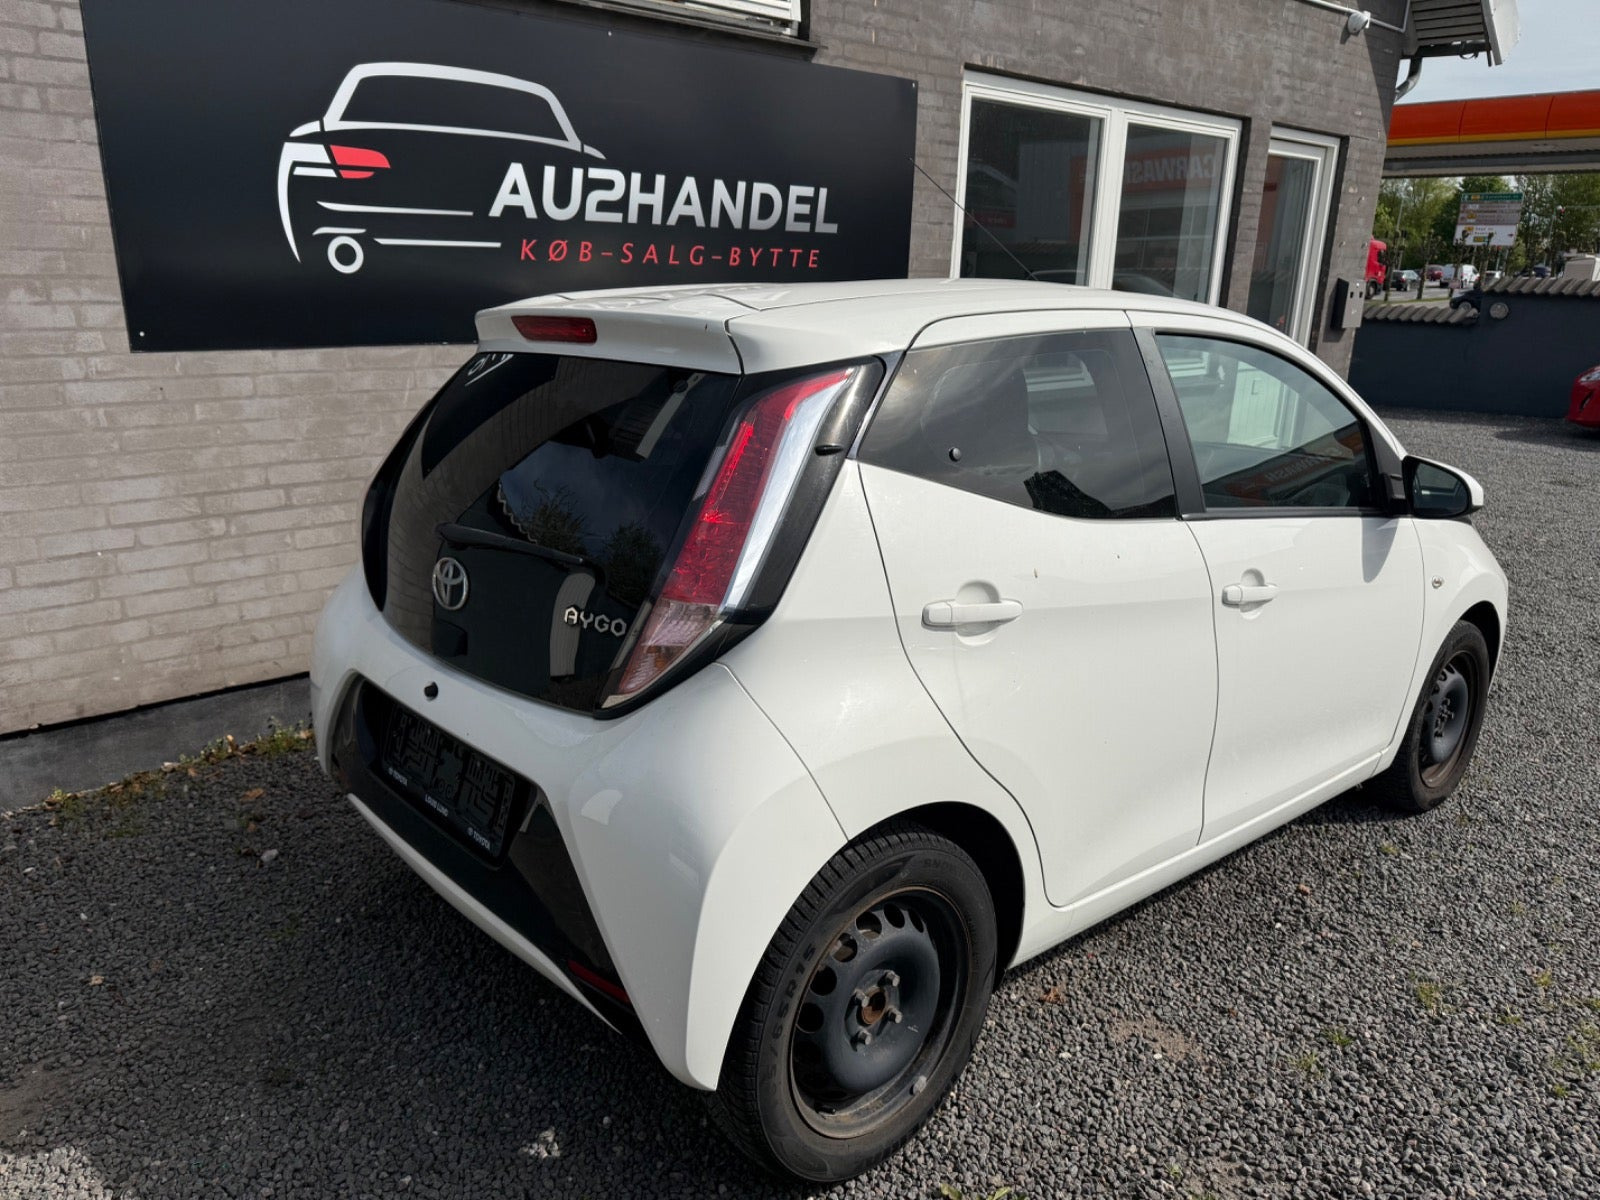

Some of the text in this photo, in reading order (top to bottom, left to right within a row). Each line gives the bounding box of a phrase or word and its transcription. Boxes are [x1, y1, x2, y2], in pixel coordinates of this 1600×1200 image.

[488, 162, 838, 234] AU2HANDEL
[520, 239, 820, 268] KØB-SALG-BYTTE
[563, 606, 627, 637] AYGO
